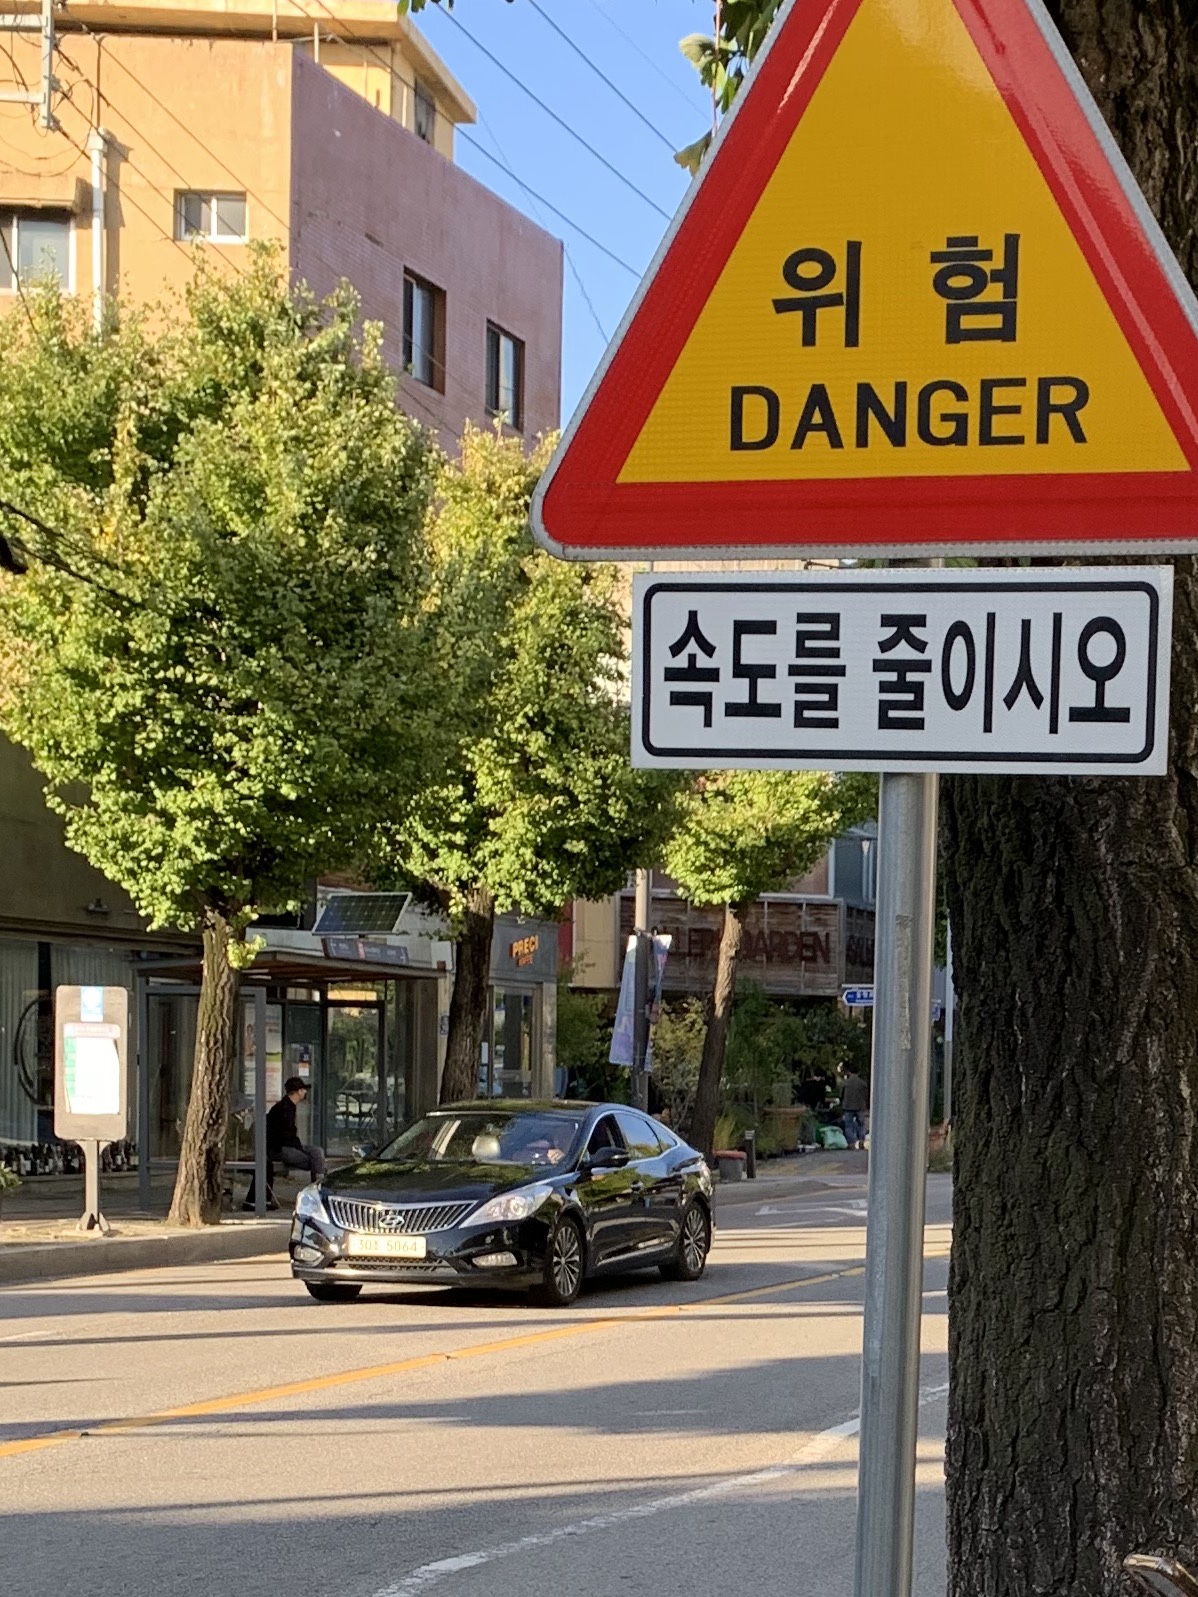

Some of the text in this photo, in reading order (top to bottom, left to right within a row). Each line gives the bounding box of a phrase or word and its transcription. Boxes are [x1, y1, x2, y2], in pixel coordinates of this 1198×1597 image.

[729, 376, 1091, 451] DANGER
[664, 610, 1131, 735] 속도를 줄이시오
